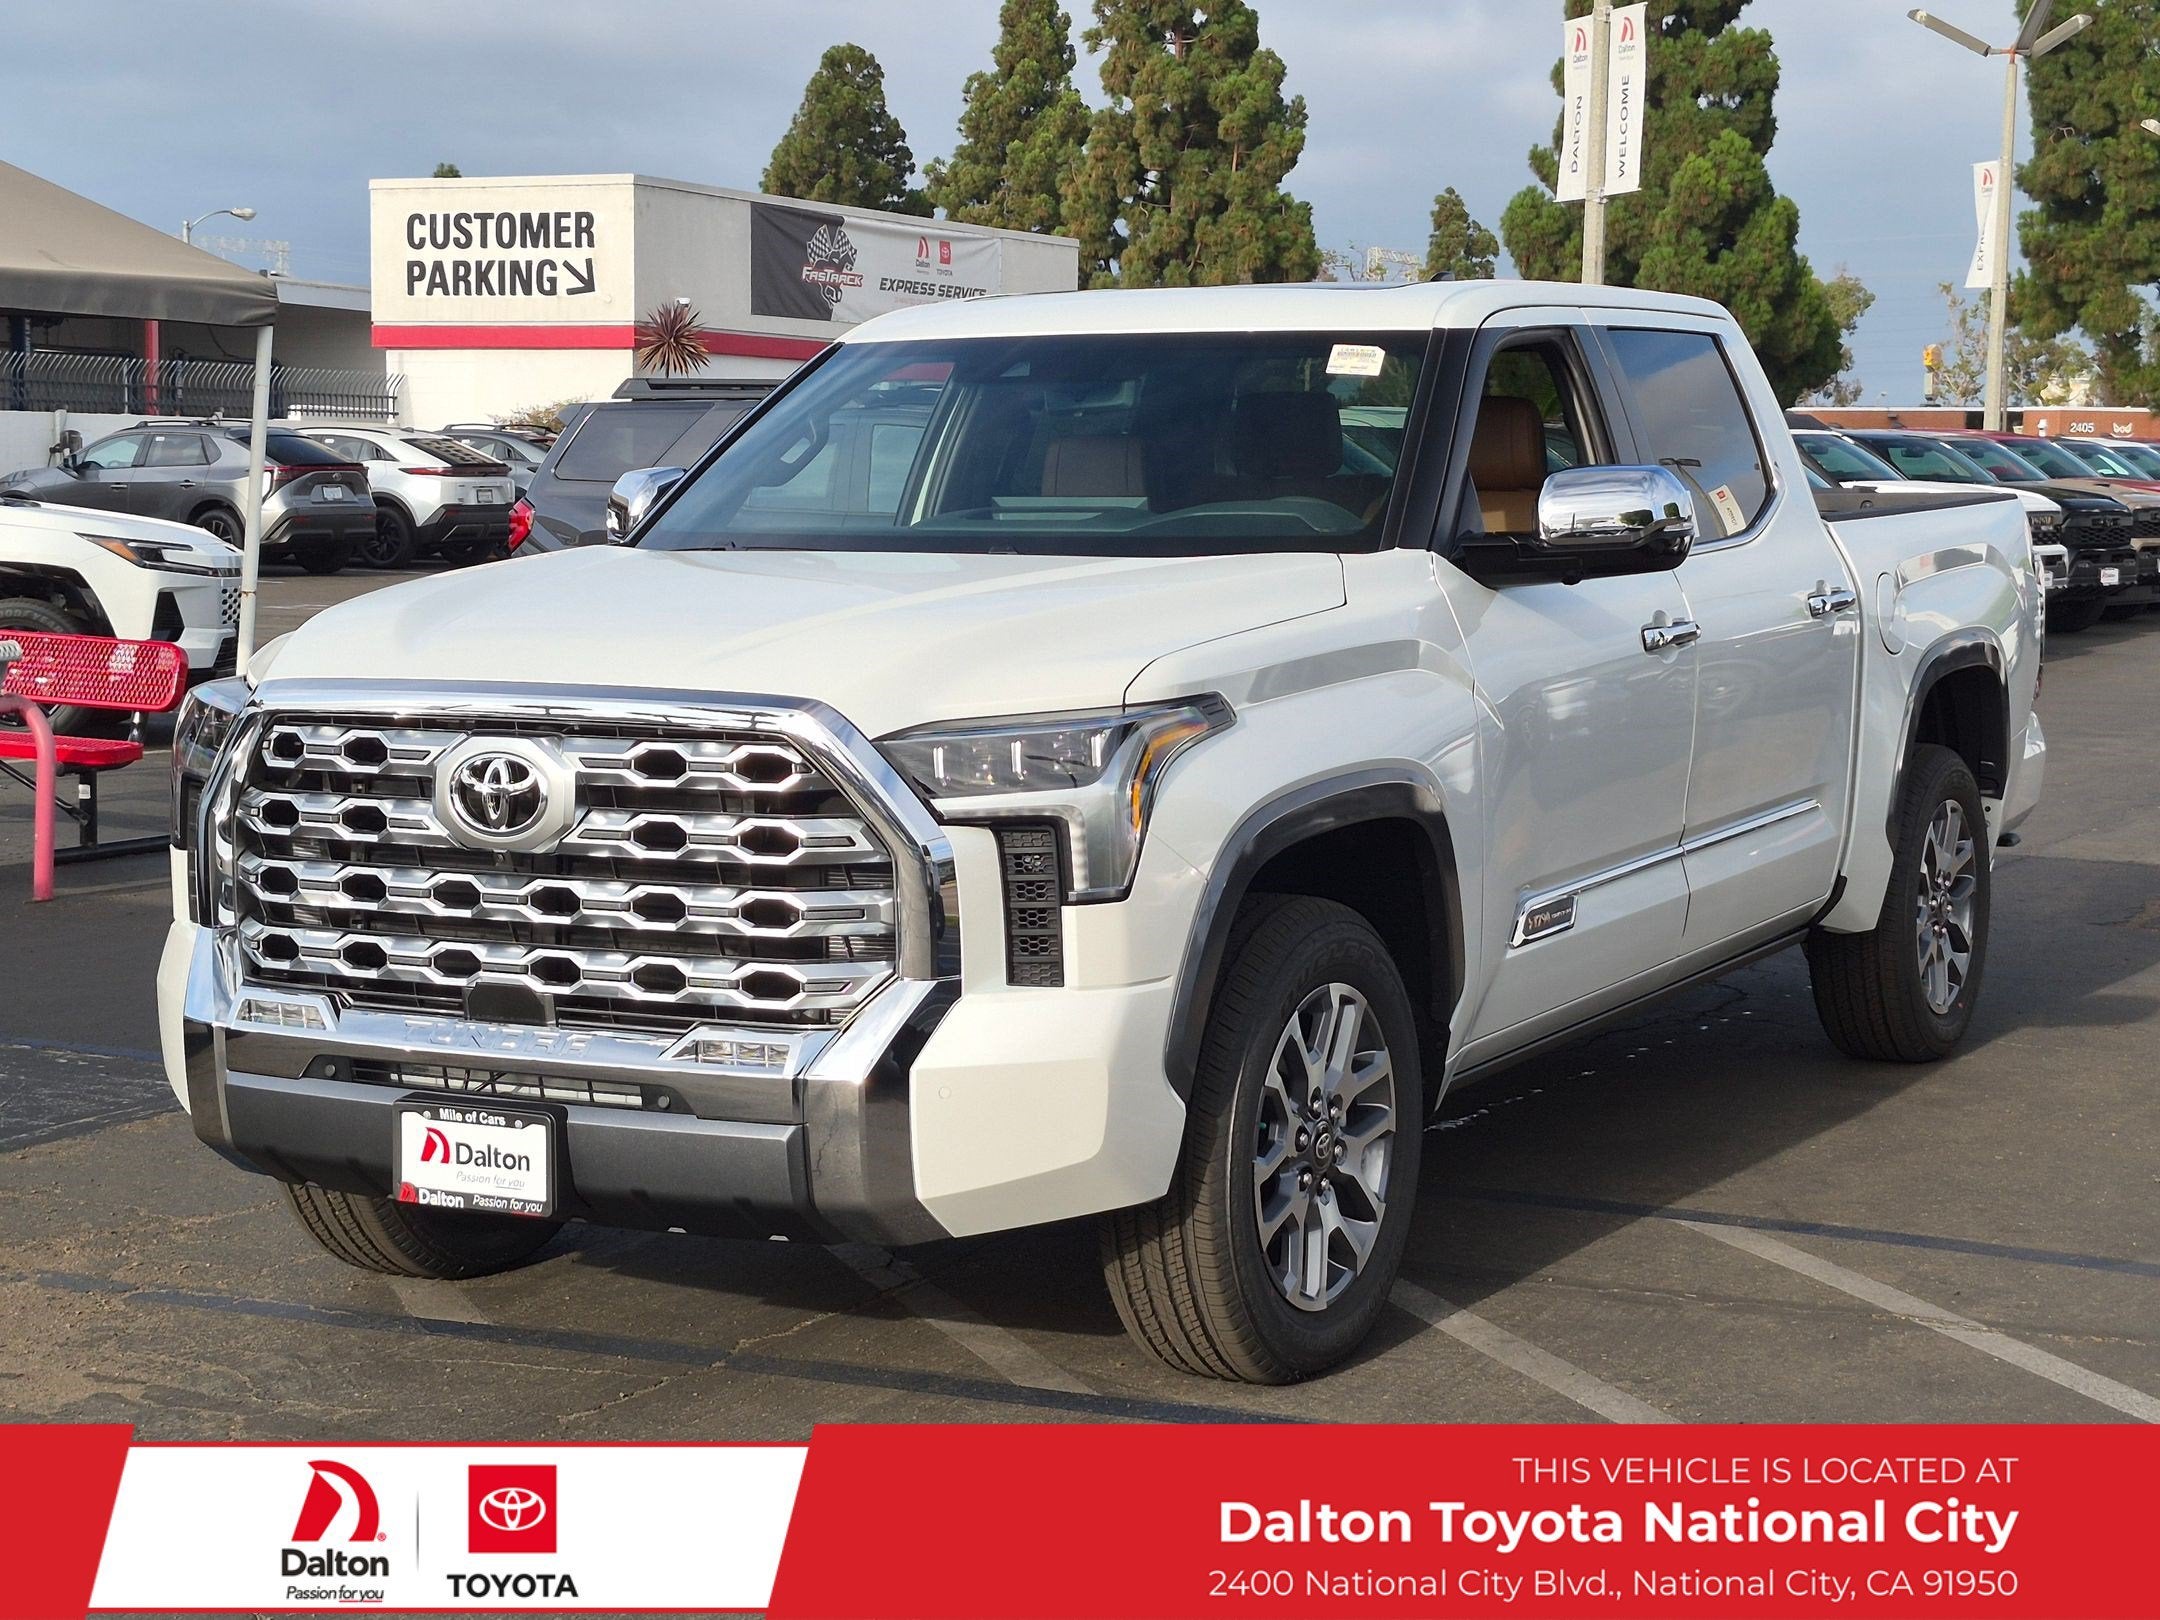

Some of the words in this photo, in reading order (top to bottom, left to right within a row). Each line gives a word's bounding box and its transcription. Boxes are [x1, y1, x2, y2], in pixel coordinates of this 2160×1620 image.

[1571, 96, 1583, 173] DALTON
[1618, 75, 1629, 178] WELCOME
[406, 211, 595, 250] CUSTOMER
[406, 259, 558, 296] PARKING
[879, 277, 936, 296] EXPRESS
[2069, 422, 2095, 434] 2405
[405, 1019, 596, 1056] TUNDRA
[439, 1108, 462, 1121] Mile
[465, 1111, 477, 1122] of
[479, 1113, 506, 1126] Cars
[455, 1141, 530, 1172] Dalton
[456, 1171, 491, 1184] Passion
[493, 1176, 507, 1186] for
[508, 1179, 525, 1189] you
[418, 1188, 464, 1209] Dalton
[472, 1194, 507, 1209] Passion
[509, 1198, 524, 1210] for
[524, 1202, 543, 1213] you
